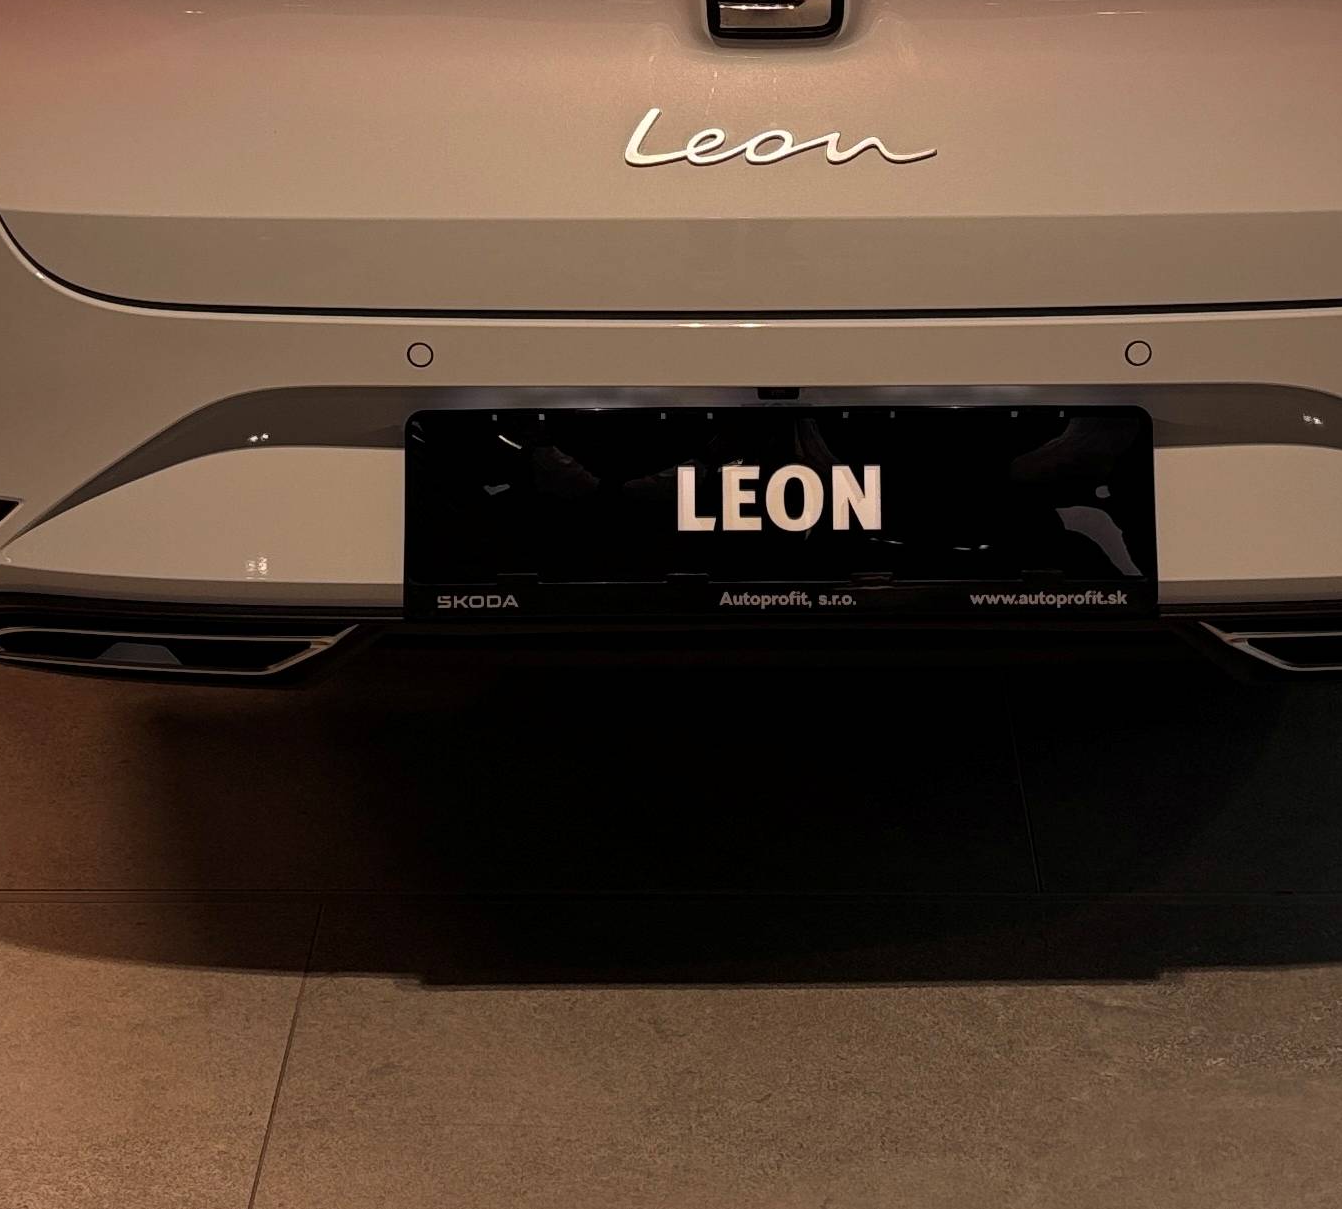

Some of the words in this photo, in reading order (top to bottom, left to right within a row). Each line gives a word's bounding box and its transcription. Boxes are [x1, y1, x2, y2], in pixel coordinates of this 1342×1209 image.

[624, 108, 938, 167] Leon
[677, 463, 882, 532] LEON
[719, 591, 812, 610] Autoprofit,
[818, 594, 857, 606] s.r.o.
[969, 590, 1128, 609] www.autoprofit.sk
